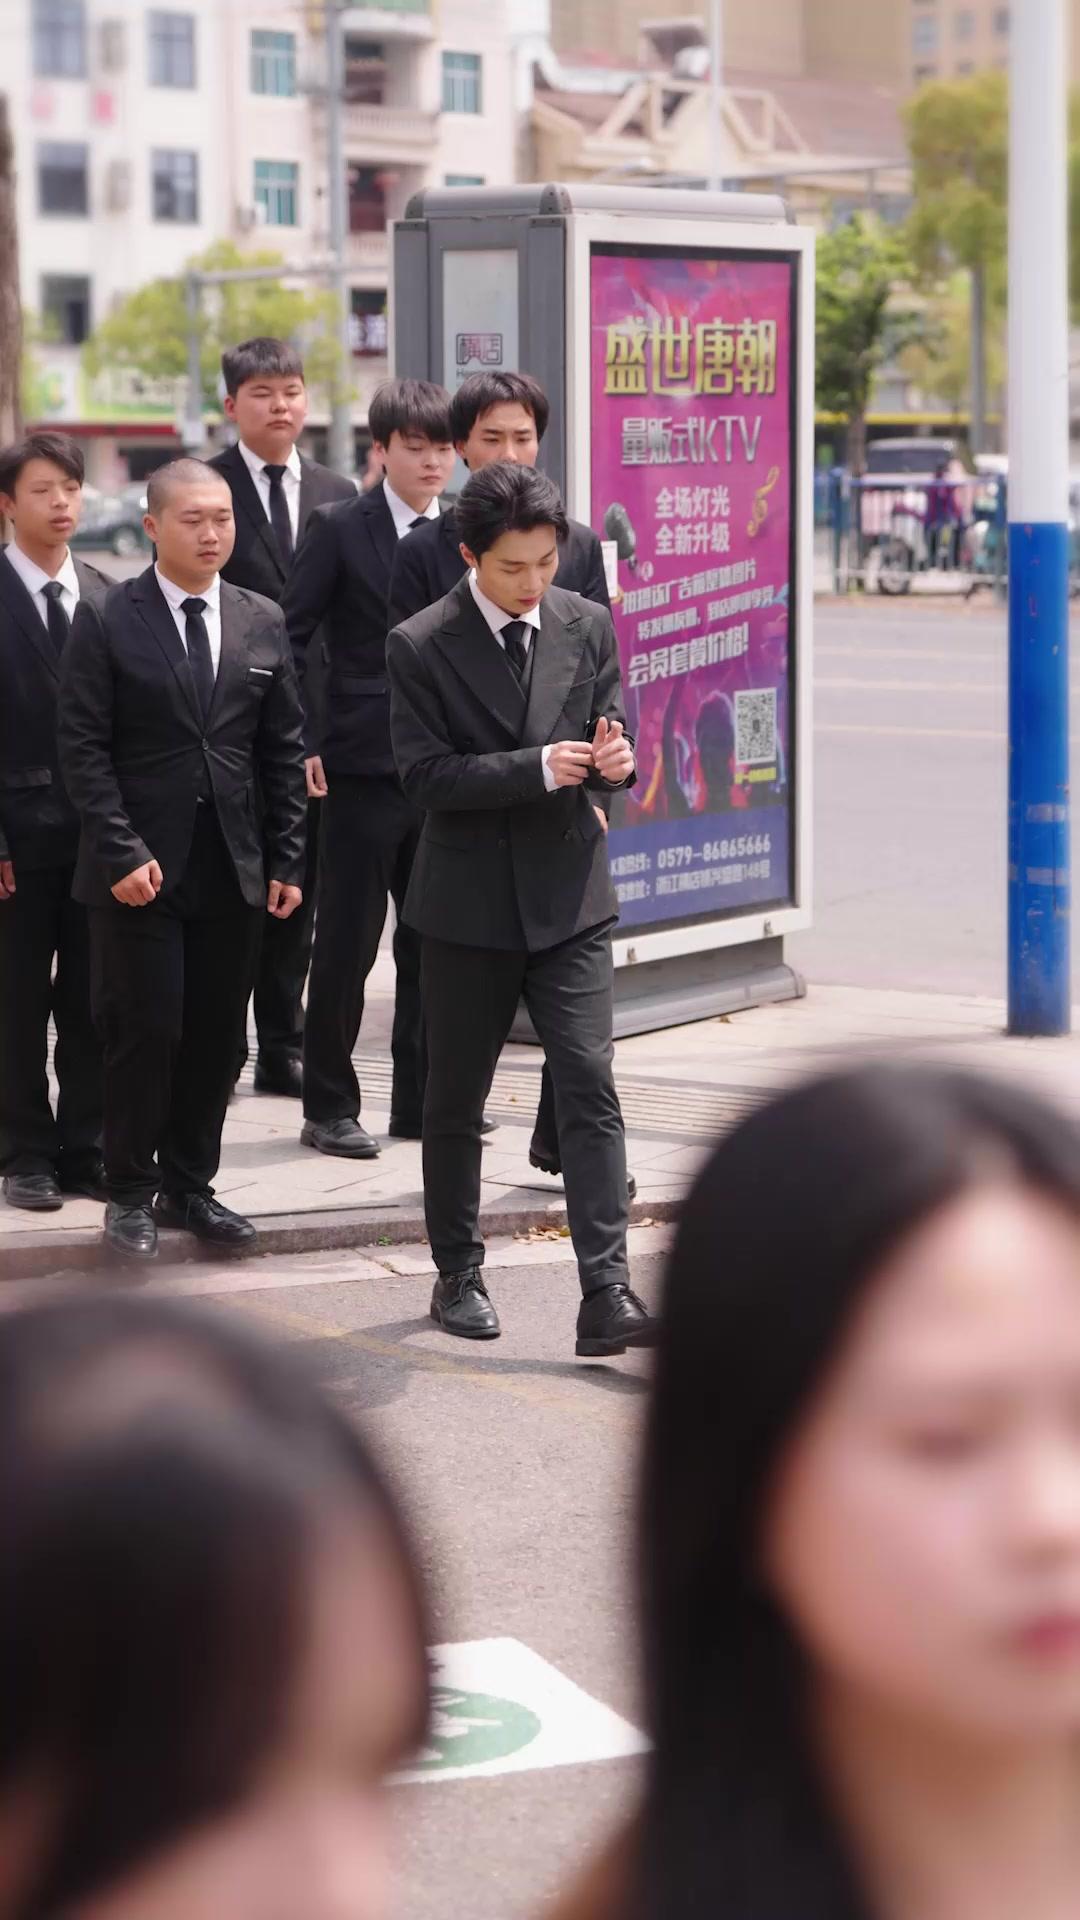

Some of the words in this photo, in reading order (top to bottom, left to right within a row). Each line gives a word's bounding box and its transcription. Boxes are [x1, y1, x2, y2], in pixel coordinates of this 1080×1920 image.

[604, 316, 776, 395] 盛世唐朝
[621, 416, 762, 464] 量贩式KTV
[655, 487, 731, 519] 全场灯光
[655, 523, 731, 555] 全新升级
